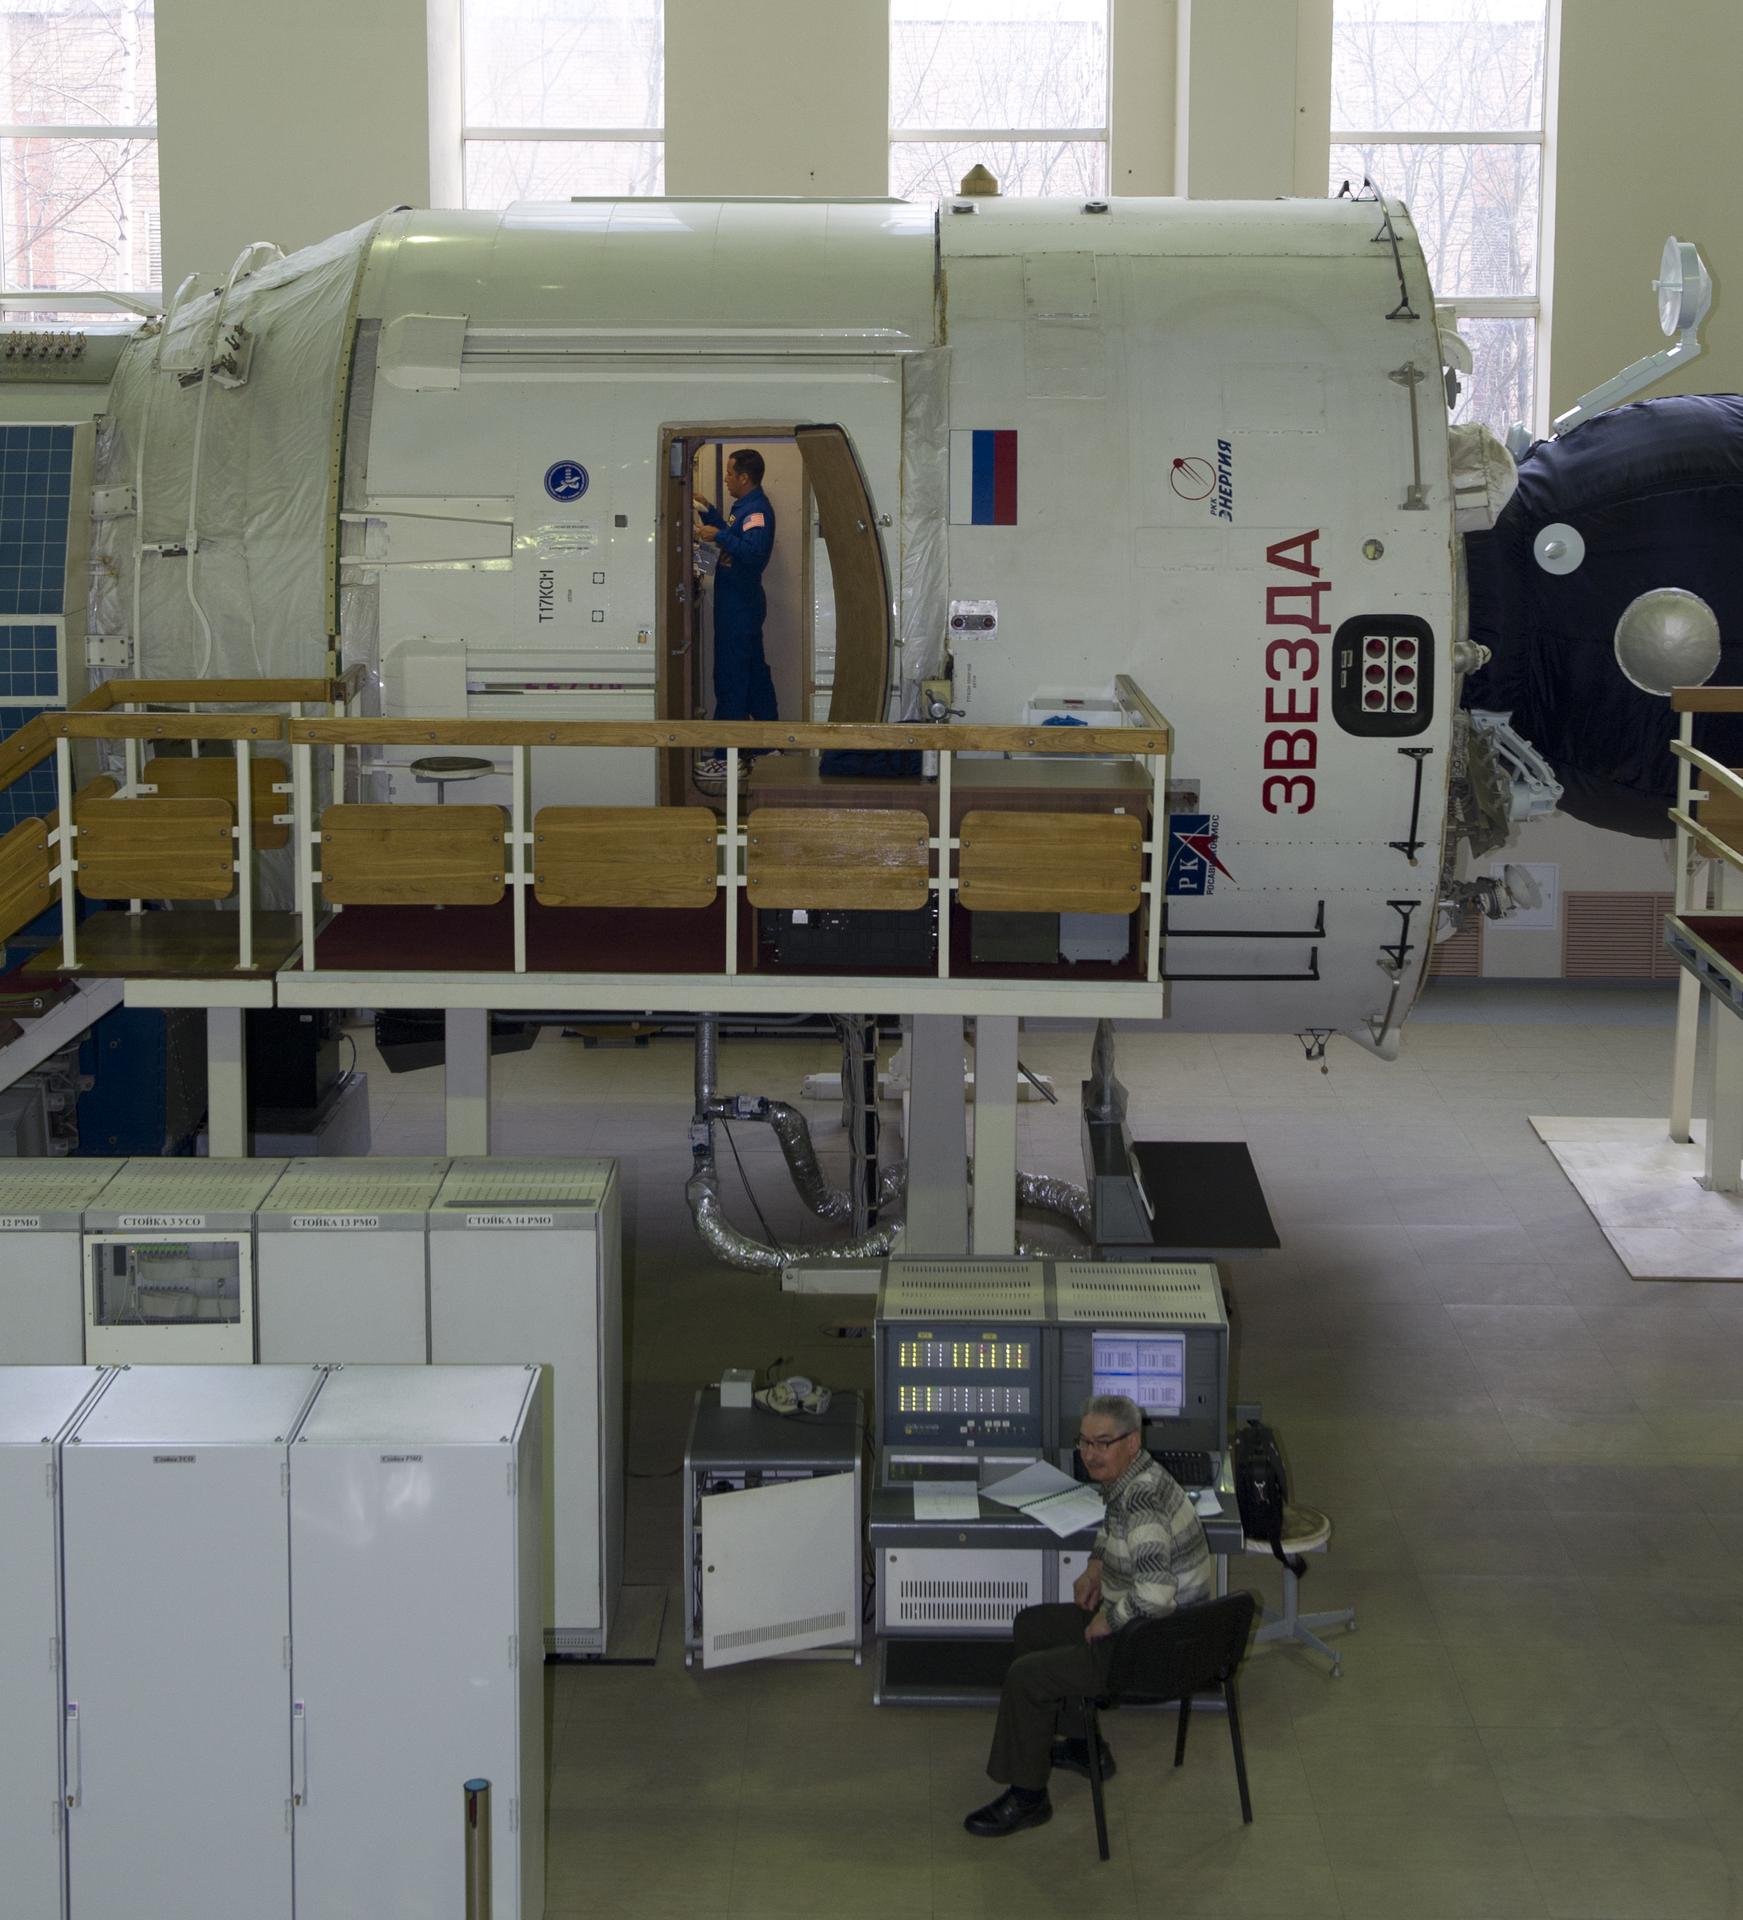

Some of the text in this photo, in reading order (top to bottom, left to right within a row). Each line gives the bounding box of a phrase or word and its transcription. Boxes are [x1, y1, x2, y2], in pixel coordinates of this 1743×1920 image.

[1217, 439, 1233, 522] ЭНЕРГИЯ
[1262, 528, 1332, 814] ЗВЕЗДА
[1206, 814, 1219, 895] РОСАВИКОСМОС
[14, 1218, 38, 1227] РМО
[123, 1216, 167, 1226] СТОЙКА
[178, 1217, 201, 1226] УСО
[293, 1216, 337, 1227] СТОЙКА
[353, 1218, 377, 1227] РМО
[468, 1215, 512, 1225] СТОЙКА
[527, 1216, 552, 1225] РМО
